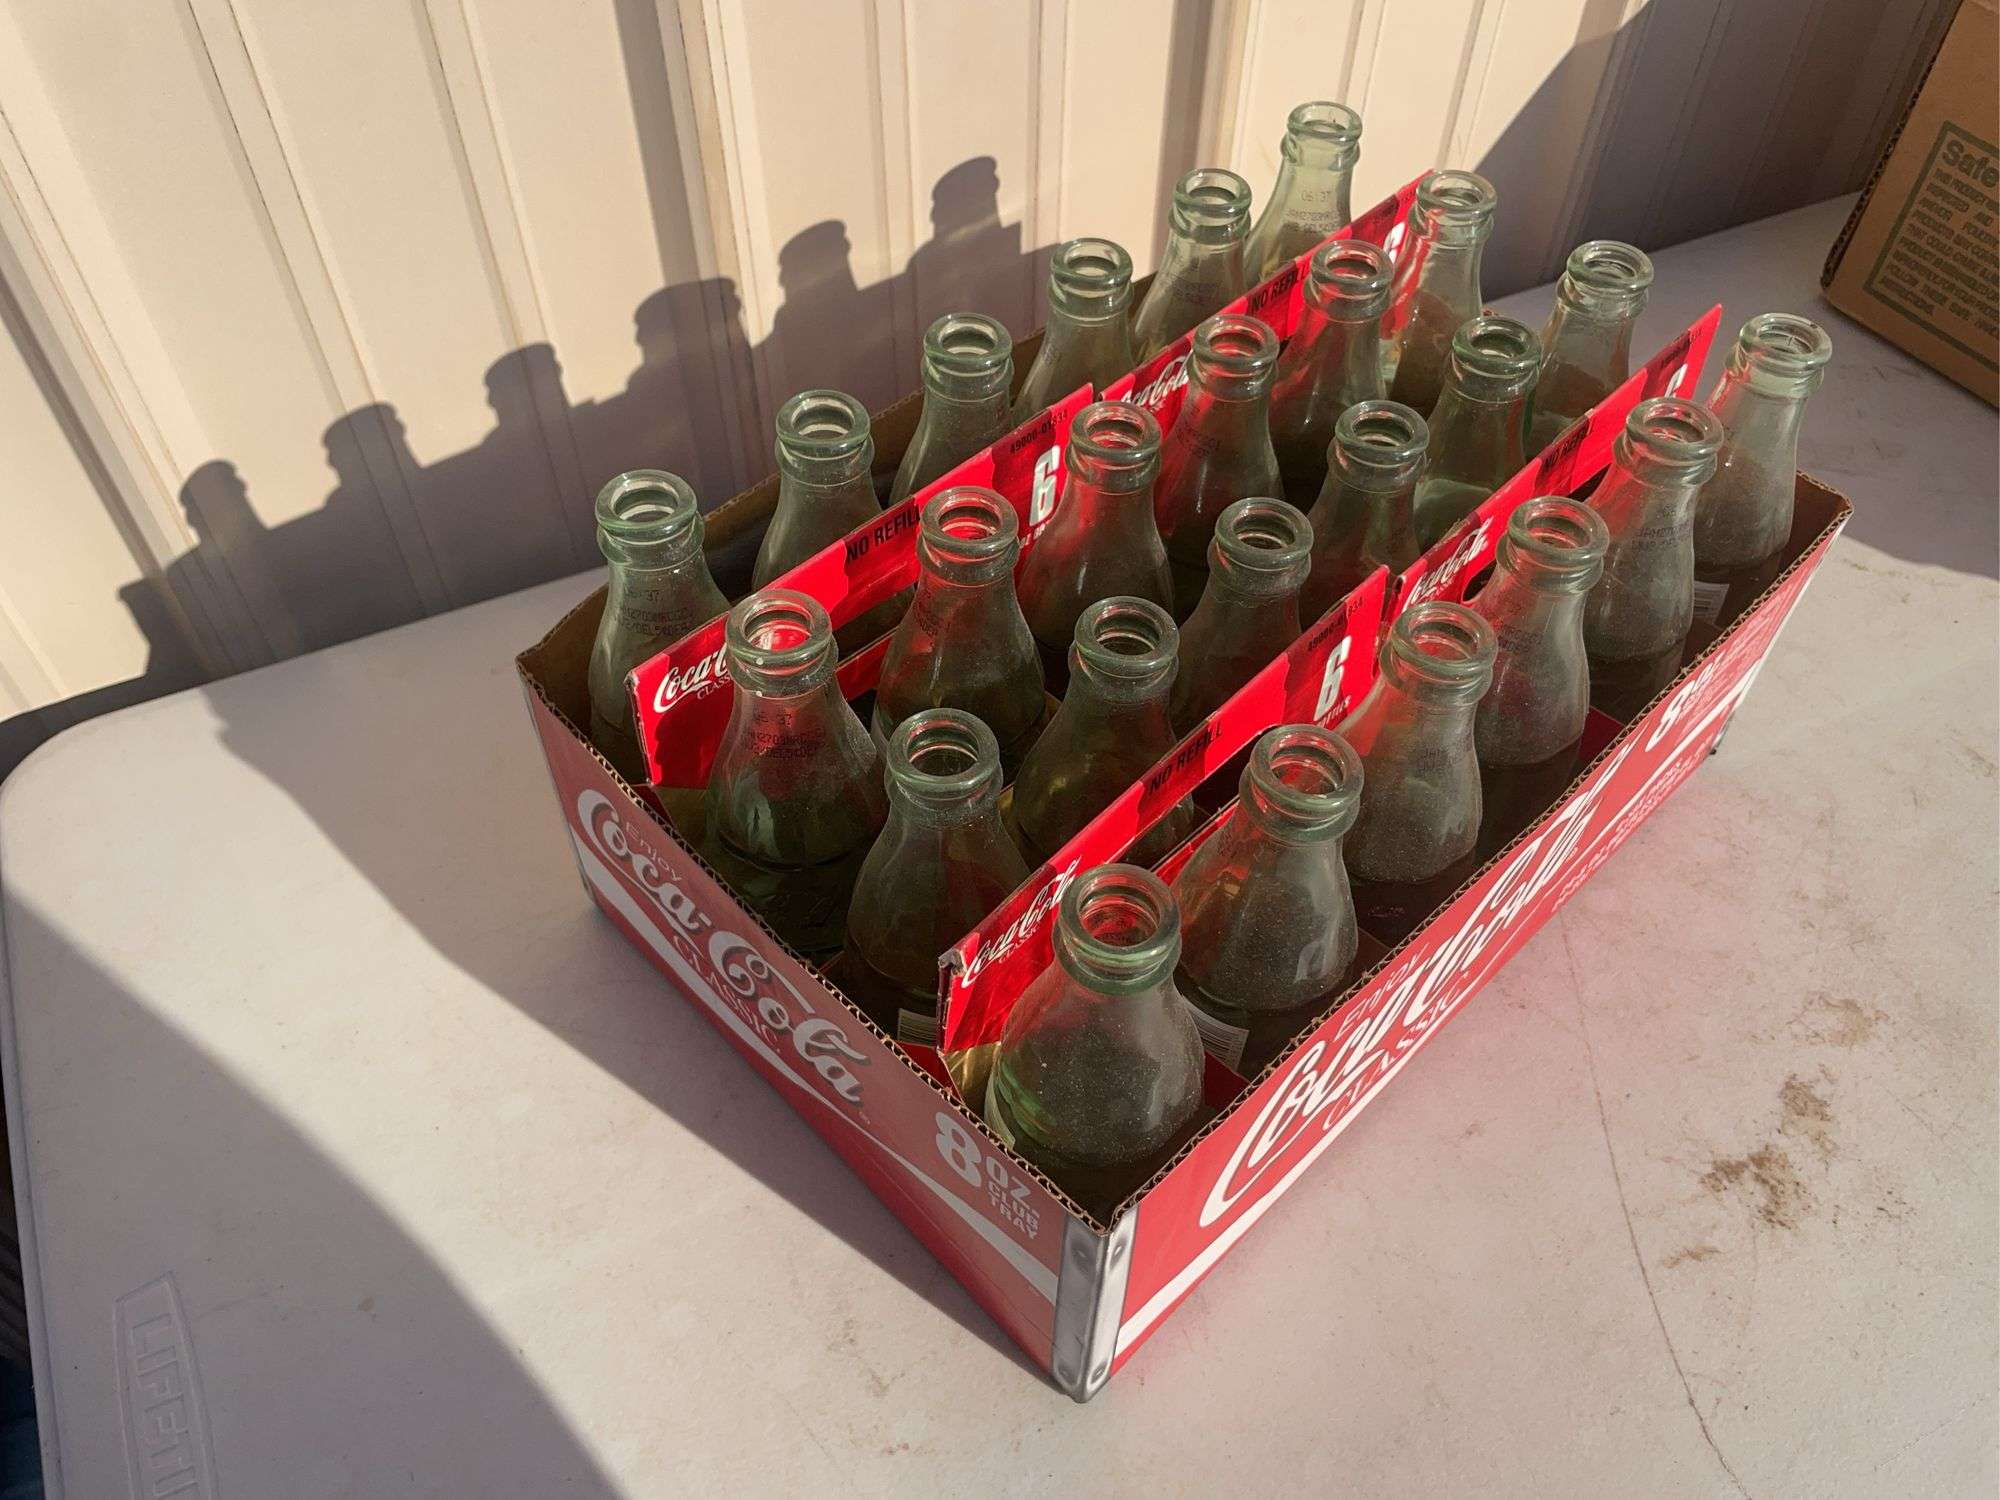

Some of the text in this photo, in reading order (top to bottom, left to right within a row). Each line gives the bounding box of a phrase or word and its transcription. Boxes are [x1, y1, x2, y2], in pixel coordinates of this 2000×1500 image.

[1029, 445, 1061, 527] 6
[845, 535, 870, 564] NO
[1313, 635, 1352, 722] 6
[1148, 765, 1172, 796] NO
[577, 789, 870, 1102] Coca-Cola
[1200, 722, 1648, 1227] Coca-Cola
[935, 1111, 982, 1188] 8
[988, 1180, 1039, 1231] CLUB
[988, 1191, 1038, 1240] TRAY
